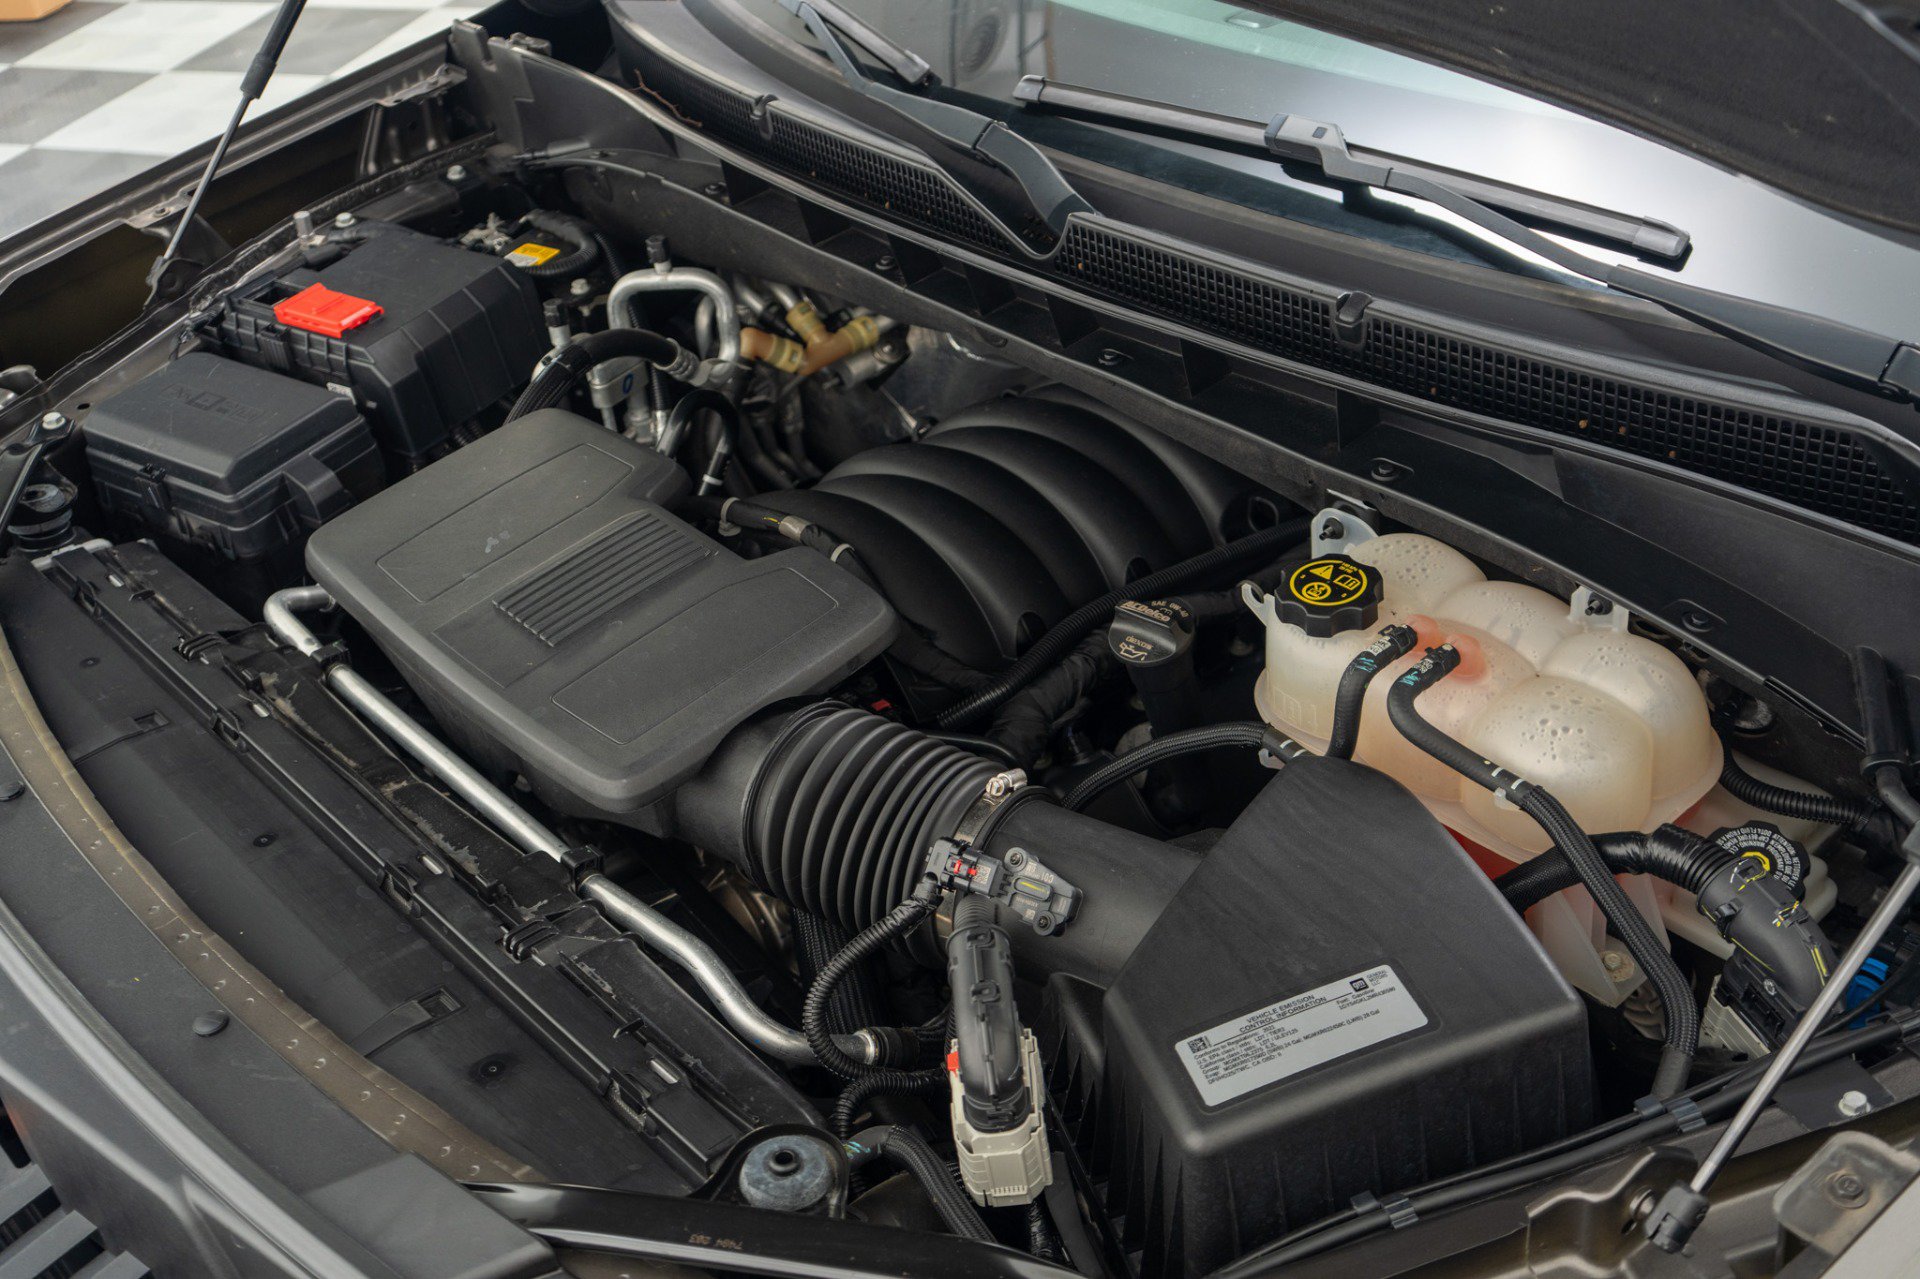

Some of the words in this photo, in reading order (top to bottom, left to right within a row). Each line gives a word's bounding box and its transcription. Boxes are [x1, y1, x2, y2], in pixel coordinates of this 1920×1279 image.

[1120, 601, 1170, 621] ACDelco
[1126, 636, 1153, 649] dexos
[1367, 970, 1386, 978] GENERAL
[1369, 974, 1388, 982] MOTORS
[1352, 989, 1374, 999] Gasoline
[1238, 1015, 1276, 1033] CONTROL
[1275, 996, 1327, 1018] INFORMATION
[1246, 1007, 1279, 1023] VEHICLE
[1278, 993, 1315, 1011] EMISSION
[1193, 1046, 1220, 1060] Conforms
[1226, 1030, 1260, 1047] Regulations:
[1262, 1024, 1275, 1033] 2021
[1199, 1055, 1225, 1069] California
[1224, 1050, 1239, 1059] class
[1258, 1038, 1270, 1046] LDT
[1272, 1027, 1298, 1040] ULEV125
[1207, 1051, 1220, 1059] EPA
[1253, 1033, 1266, 1042] LDT
